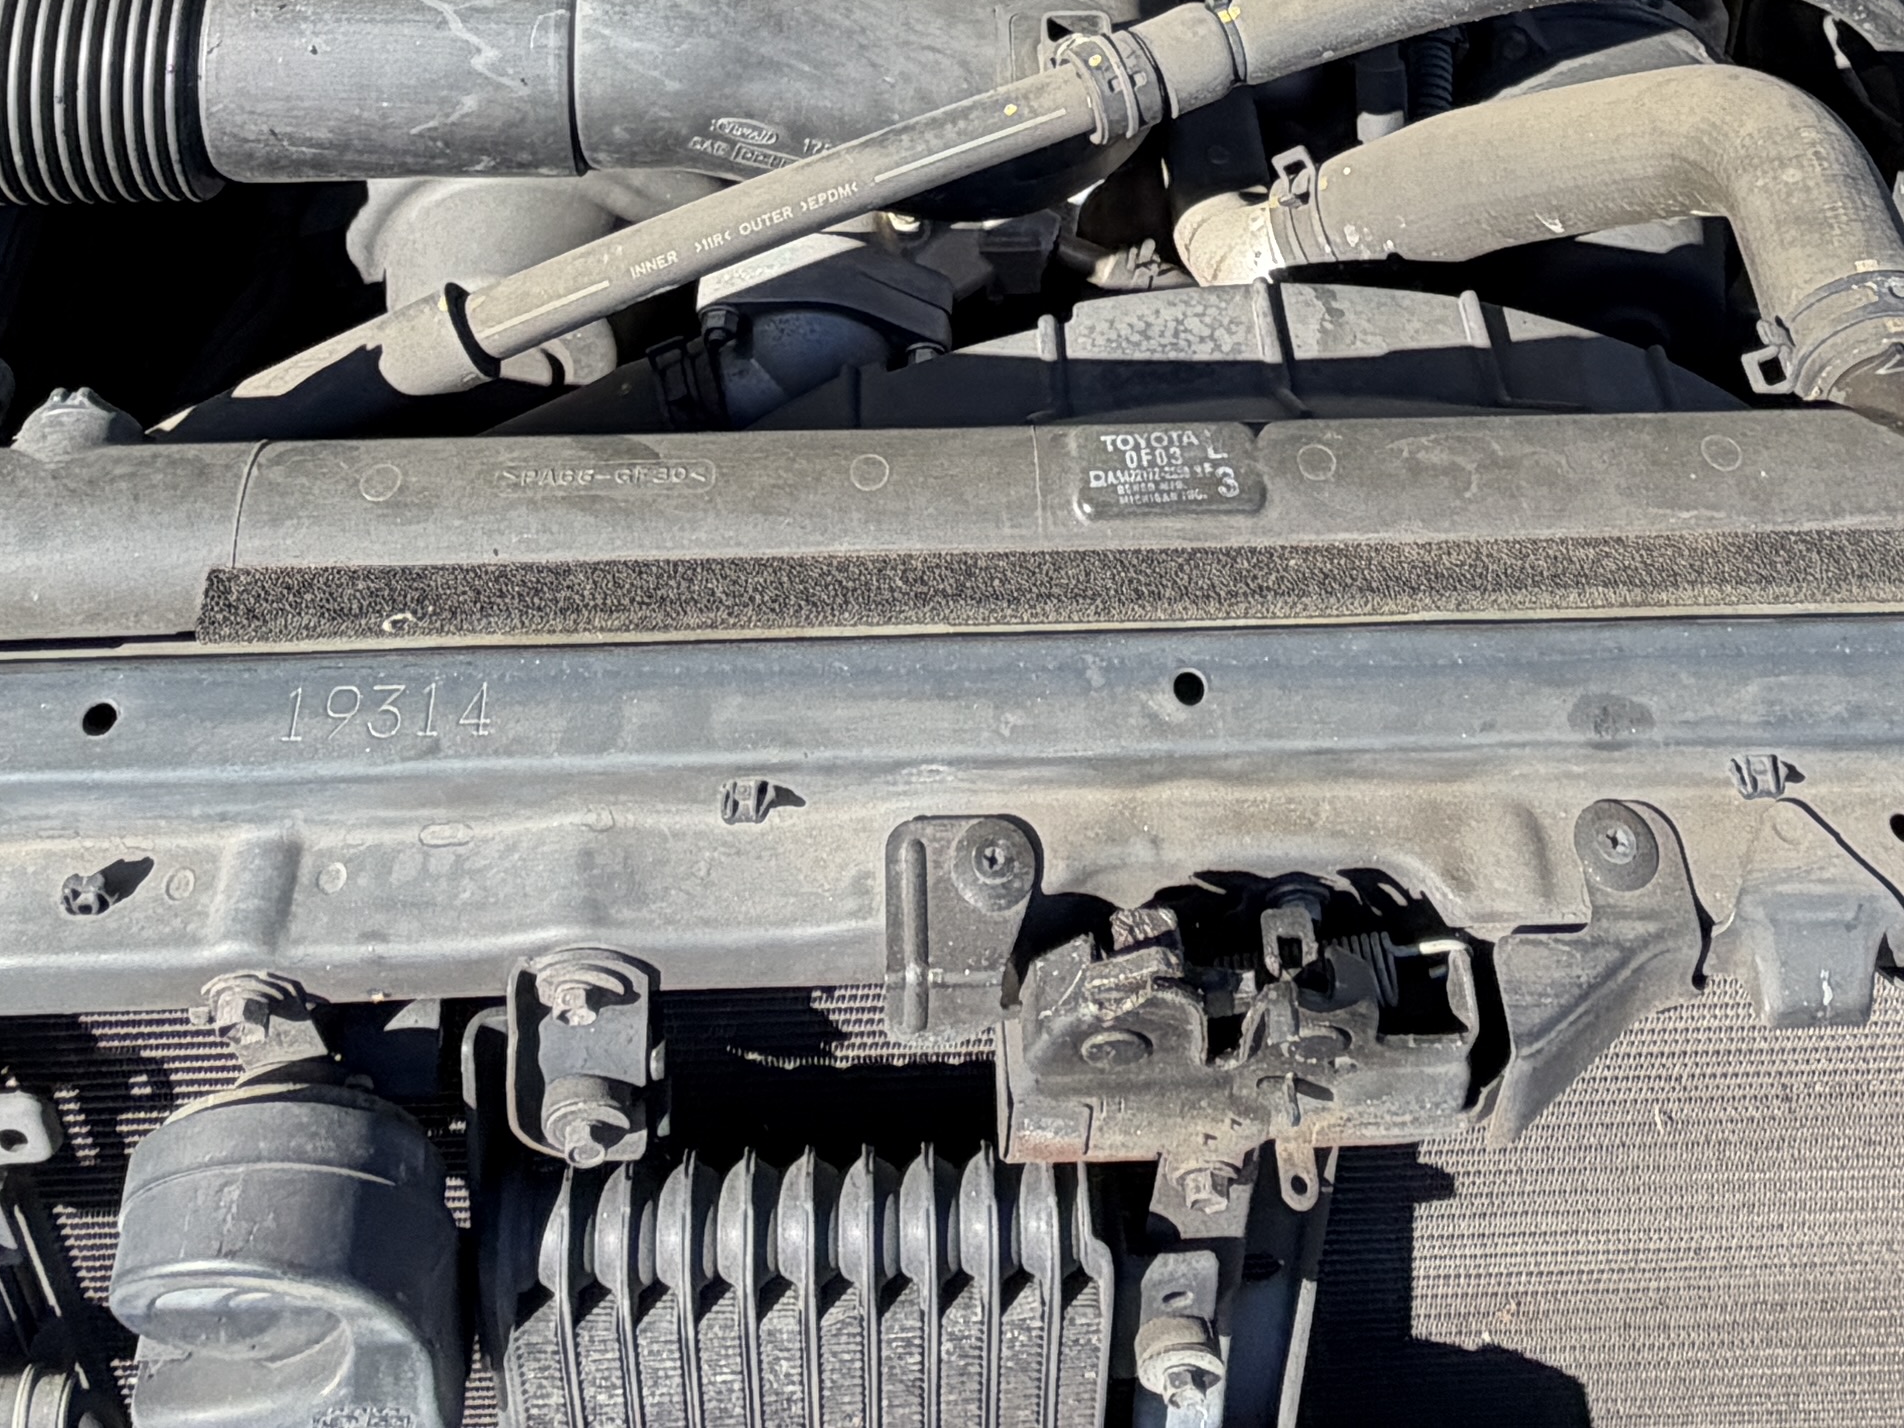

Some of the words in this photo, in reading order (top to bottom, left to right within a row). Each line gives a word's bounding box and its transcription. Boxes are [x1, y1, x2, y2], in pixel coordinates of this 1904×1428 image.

[628, 249, 679, 279] INNER
[738, 205, 794, 236] OUTER
[800, 180, 859, 212] >EPDM<
[1099, 429, 1199, 452] TOYOTA
[1125, 447, 1183, 469] 0F03
[1214, 465, 1240, 498] 3
[1119, 492, 1179, 505] MICHIGAN
[280, 681, 492, 742] 19314
